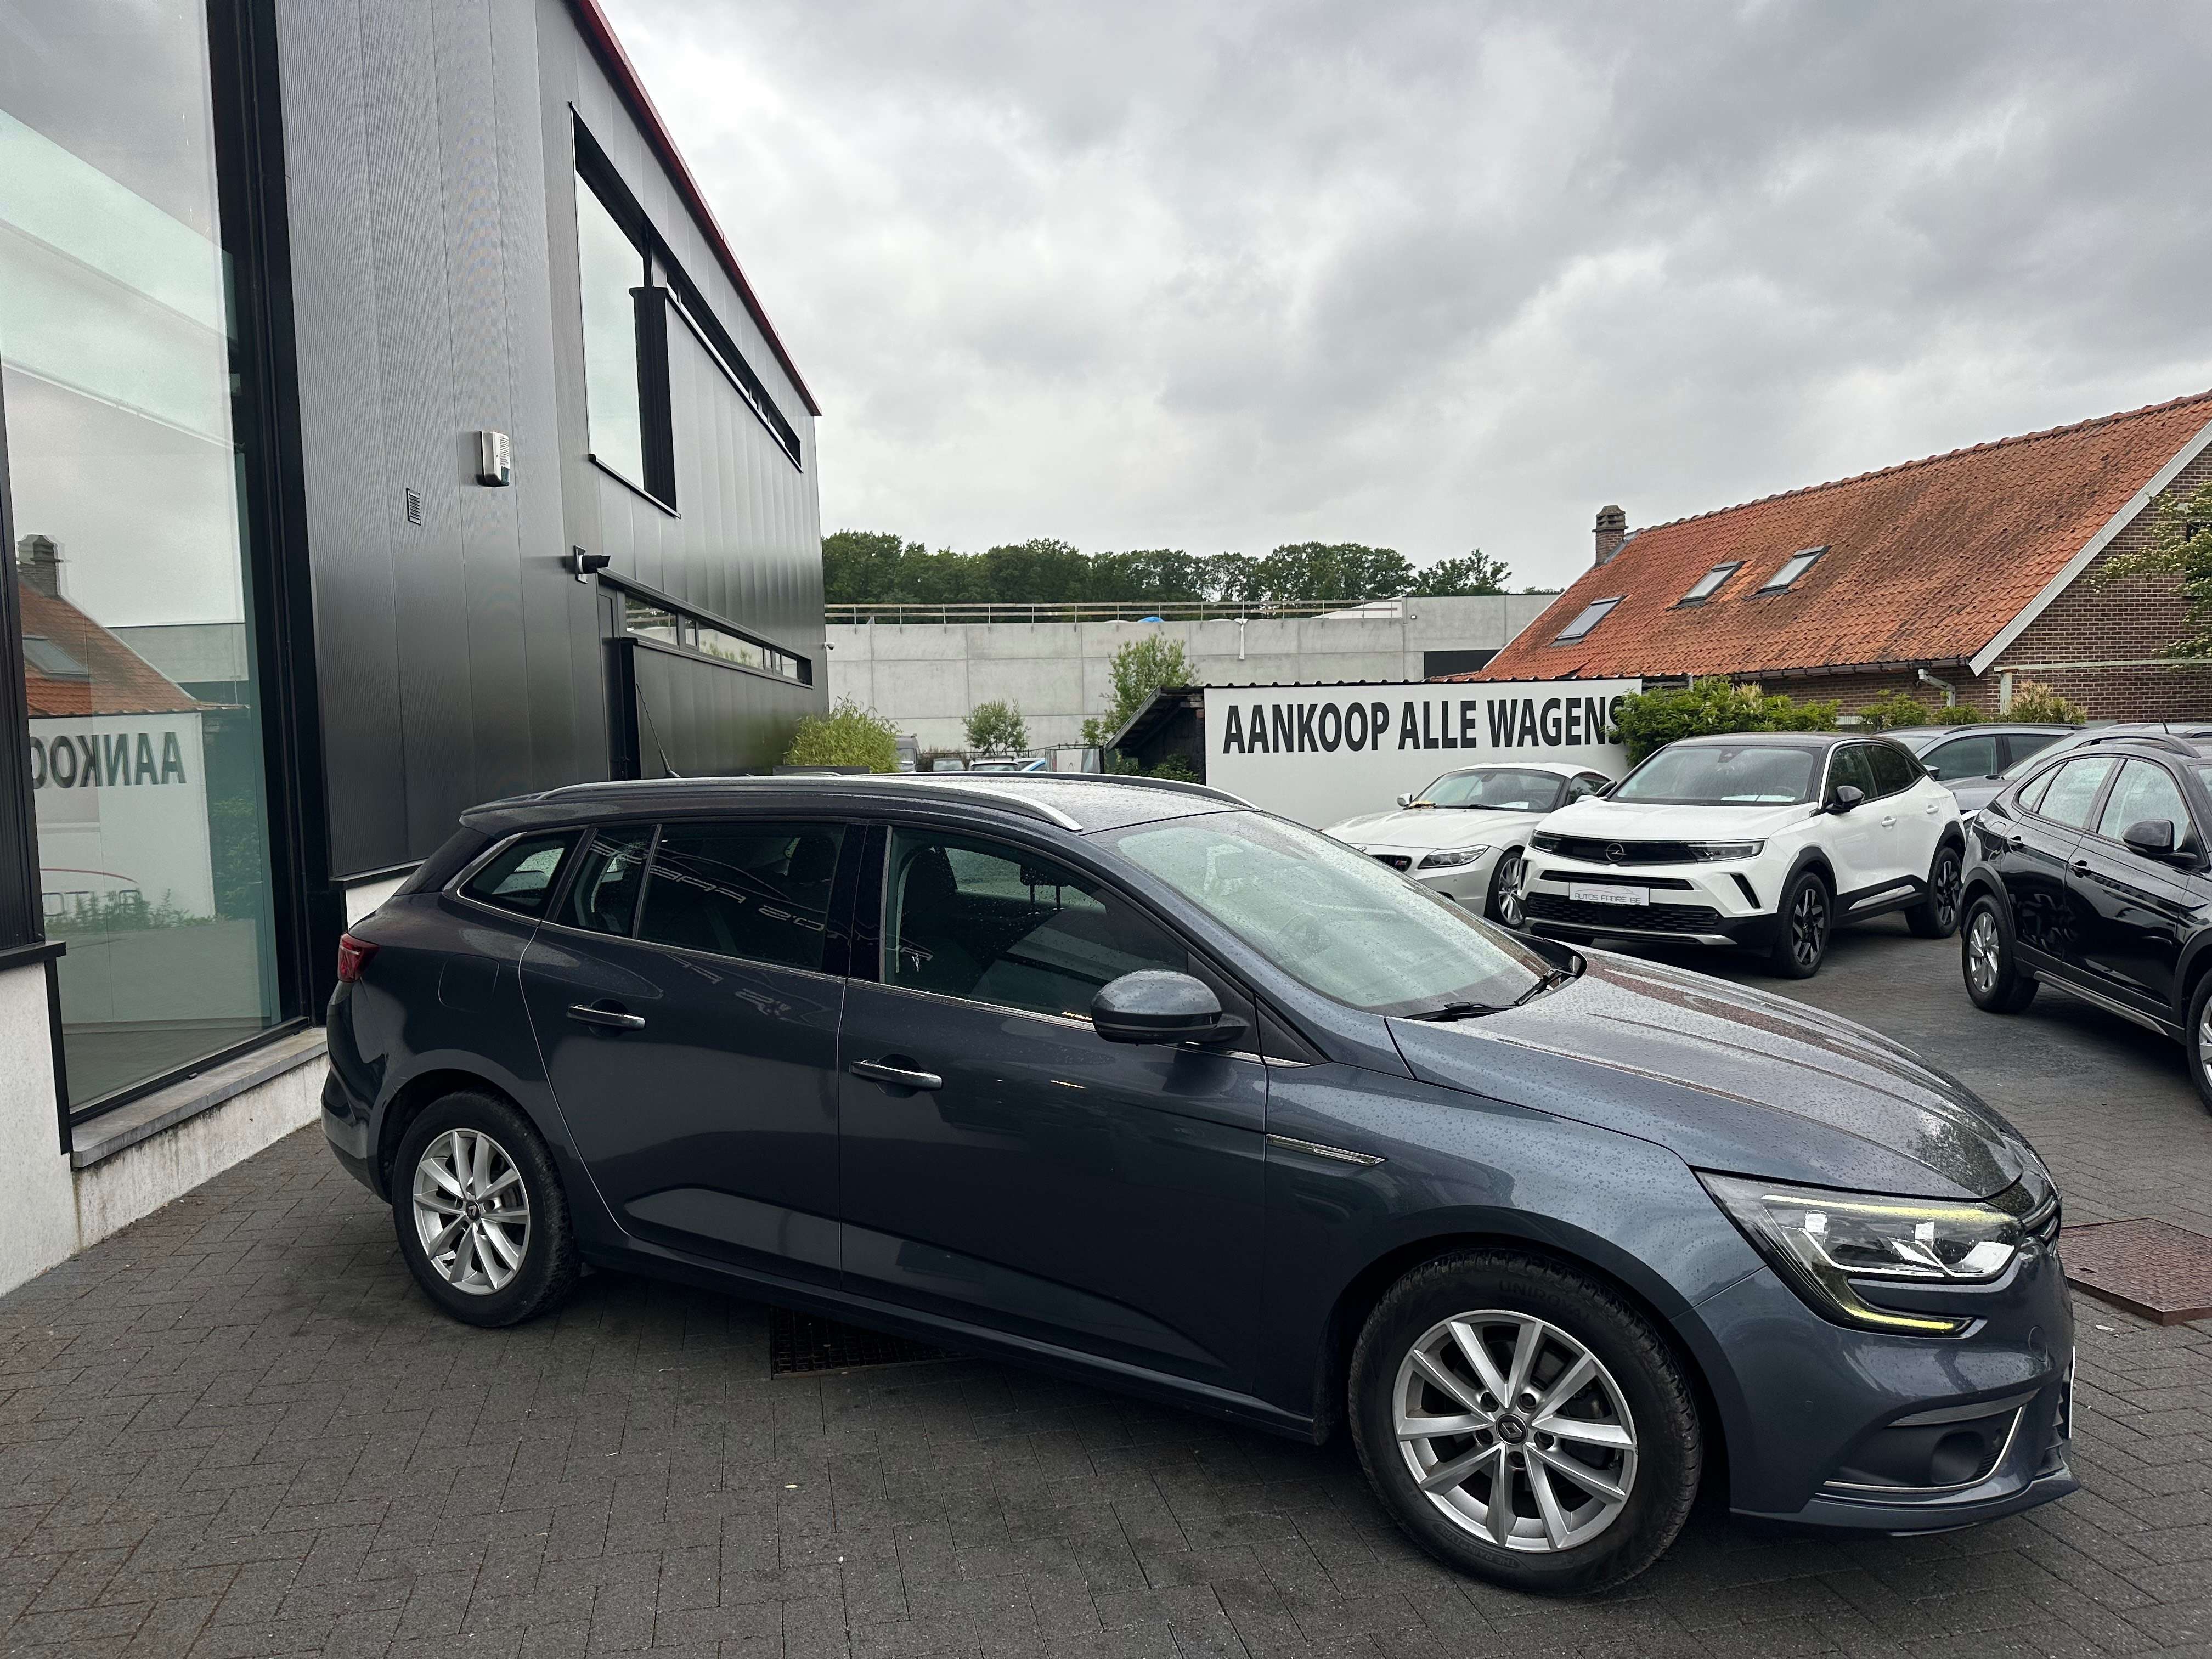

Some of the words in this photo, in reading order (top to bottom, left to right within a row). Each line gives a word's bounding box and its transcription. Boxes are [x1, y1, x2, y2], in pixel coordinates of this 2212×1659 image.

[1223, 701, 1390, 754] AANKOOP
[1398, 700, 1477, 750] ALLE
[1574, 893, 1598, 901] AUTOS
[1601, 895, 1627, 903] FABRE
